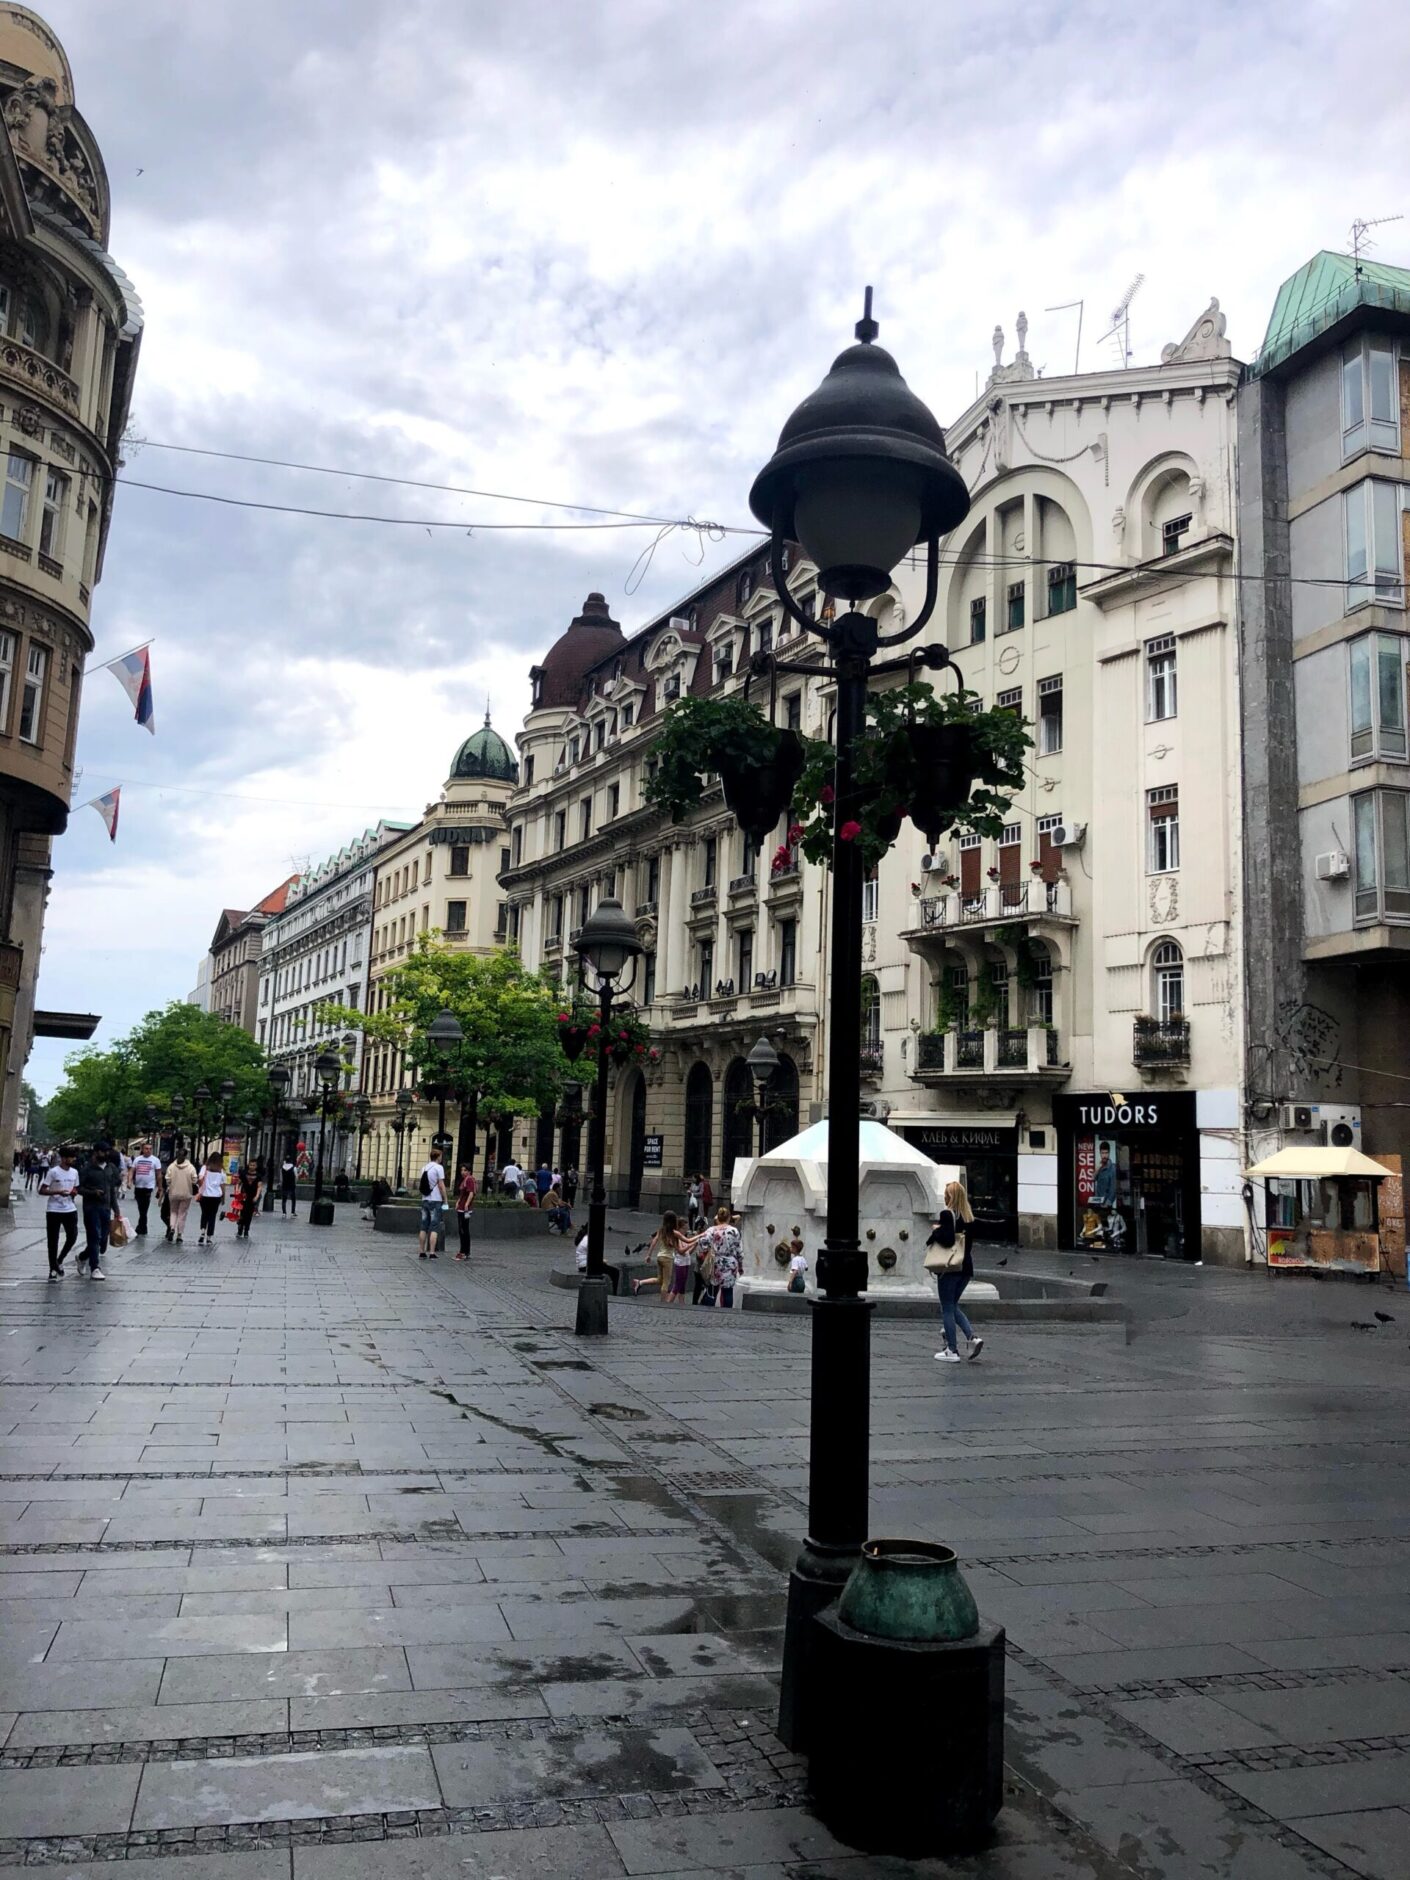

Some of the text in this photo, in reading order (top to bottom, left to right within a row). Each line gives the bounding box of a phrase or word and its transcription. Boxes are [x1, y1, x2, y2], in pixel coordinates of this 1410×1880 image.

[1079, 1105, 1158, 1124] TUDORS
[950, 1131, 958, 1144] &
[961, 1131, 1000, 1145] КИФЛЕ
[1078, 1153, 1094, 1166] SE
[1078, 1168, 1094, 1180] AS
[1078, 1181, 1094, 1193] ON
